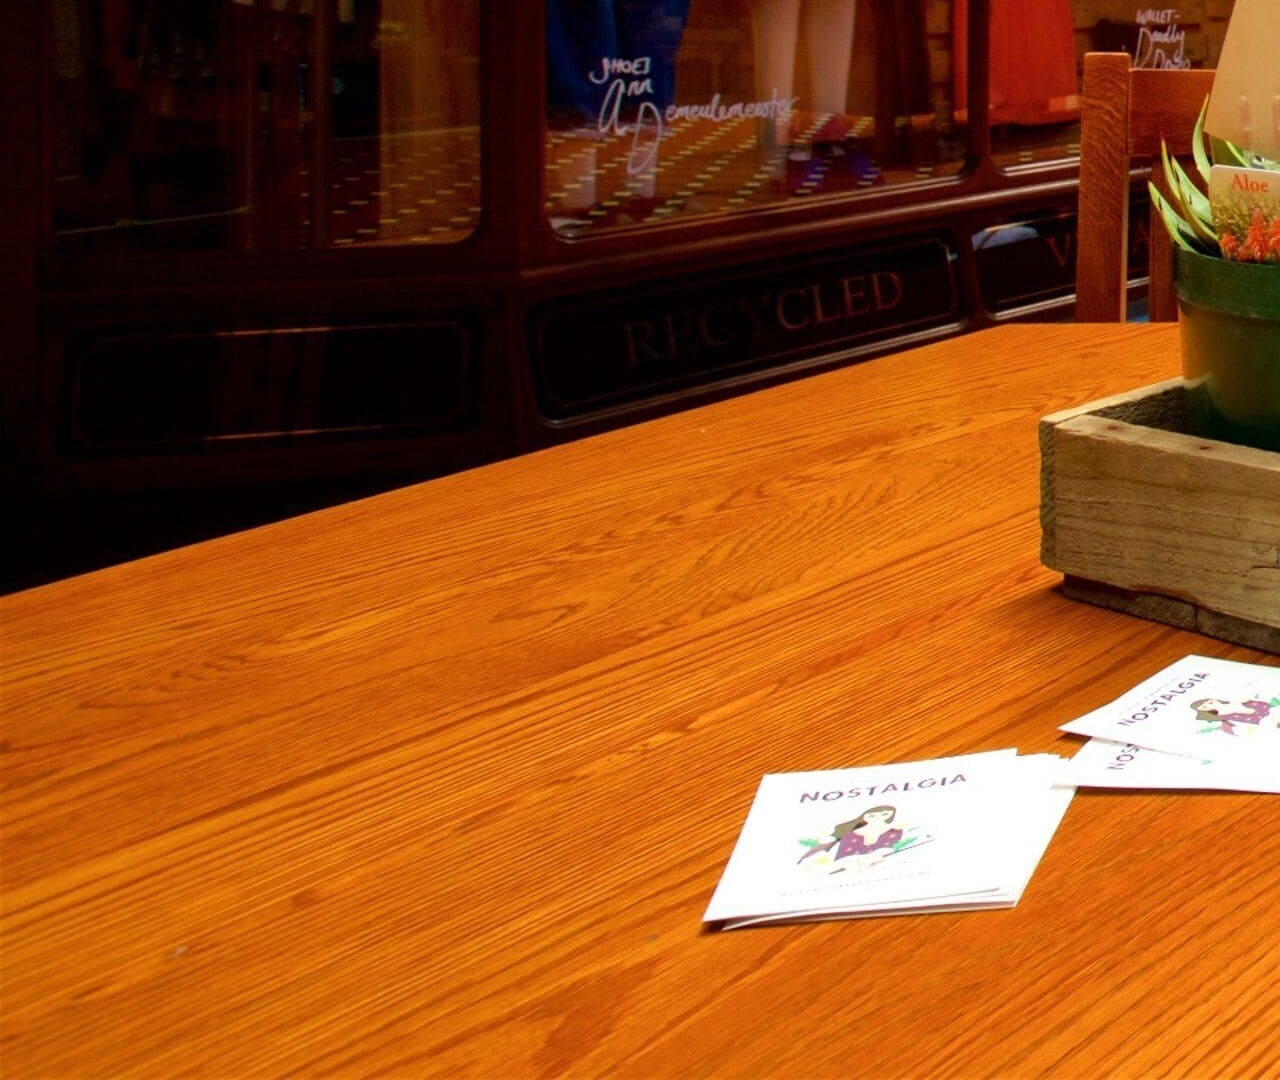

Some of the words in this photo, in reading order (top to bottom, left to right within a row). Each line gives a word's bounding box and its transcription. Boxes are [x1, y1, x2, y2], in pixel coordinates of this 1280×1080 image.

[1232, 174, 1269, 192] Aloe
[1117, 672, 1209, 726] NOSTALGIA
[1105, 744, 1140, 770] NOS
[799, 774, 967, 803] NOSTALGIA
